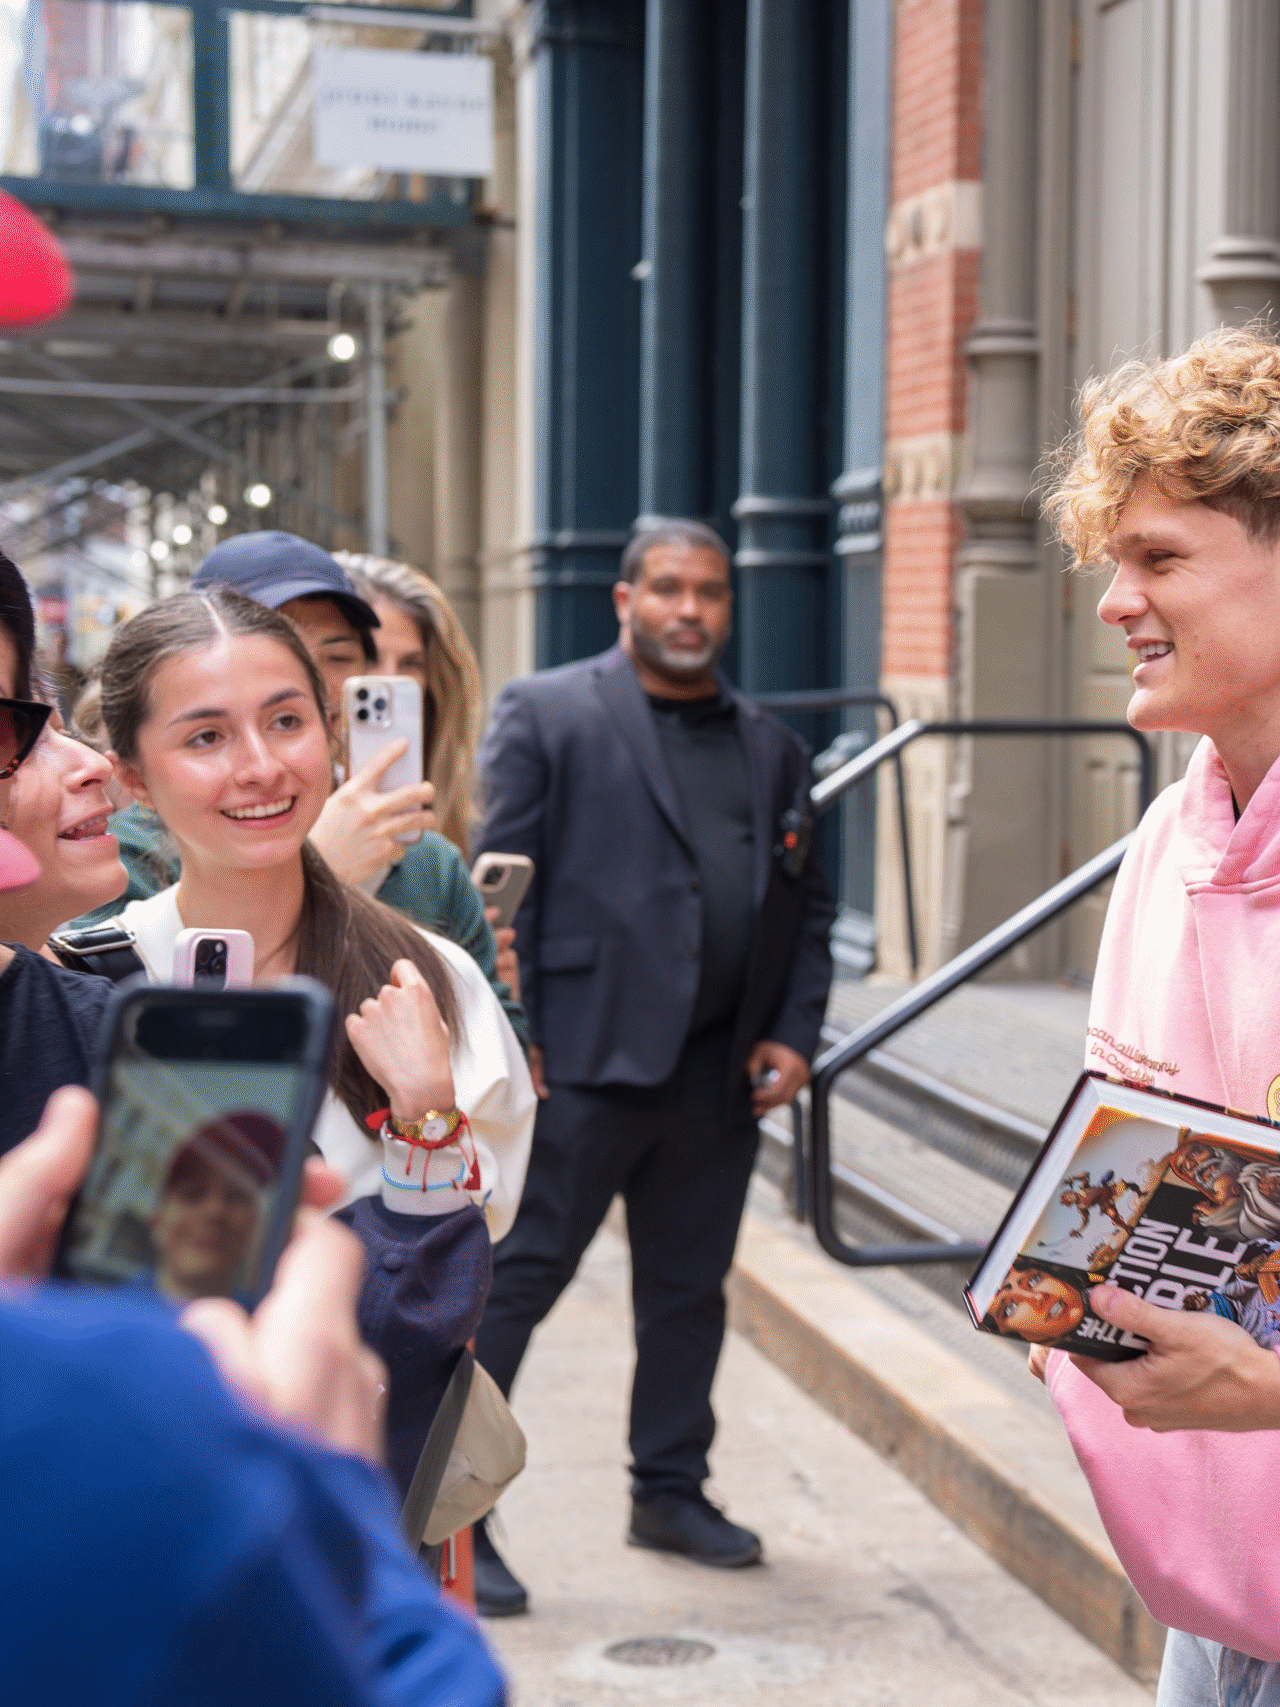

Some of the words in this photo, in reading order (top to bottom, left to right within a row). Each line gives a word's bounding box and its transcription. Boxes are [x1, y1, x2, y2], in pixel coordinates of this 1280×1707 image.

[1091, 1042, 1105, 1060] in
[1104, 1217, 1181, 1298] TION
[1076, 1316, 1119, 1344] THE
